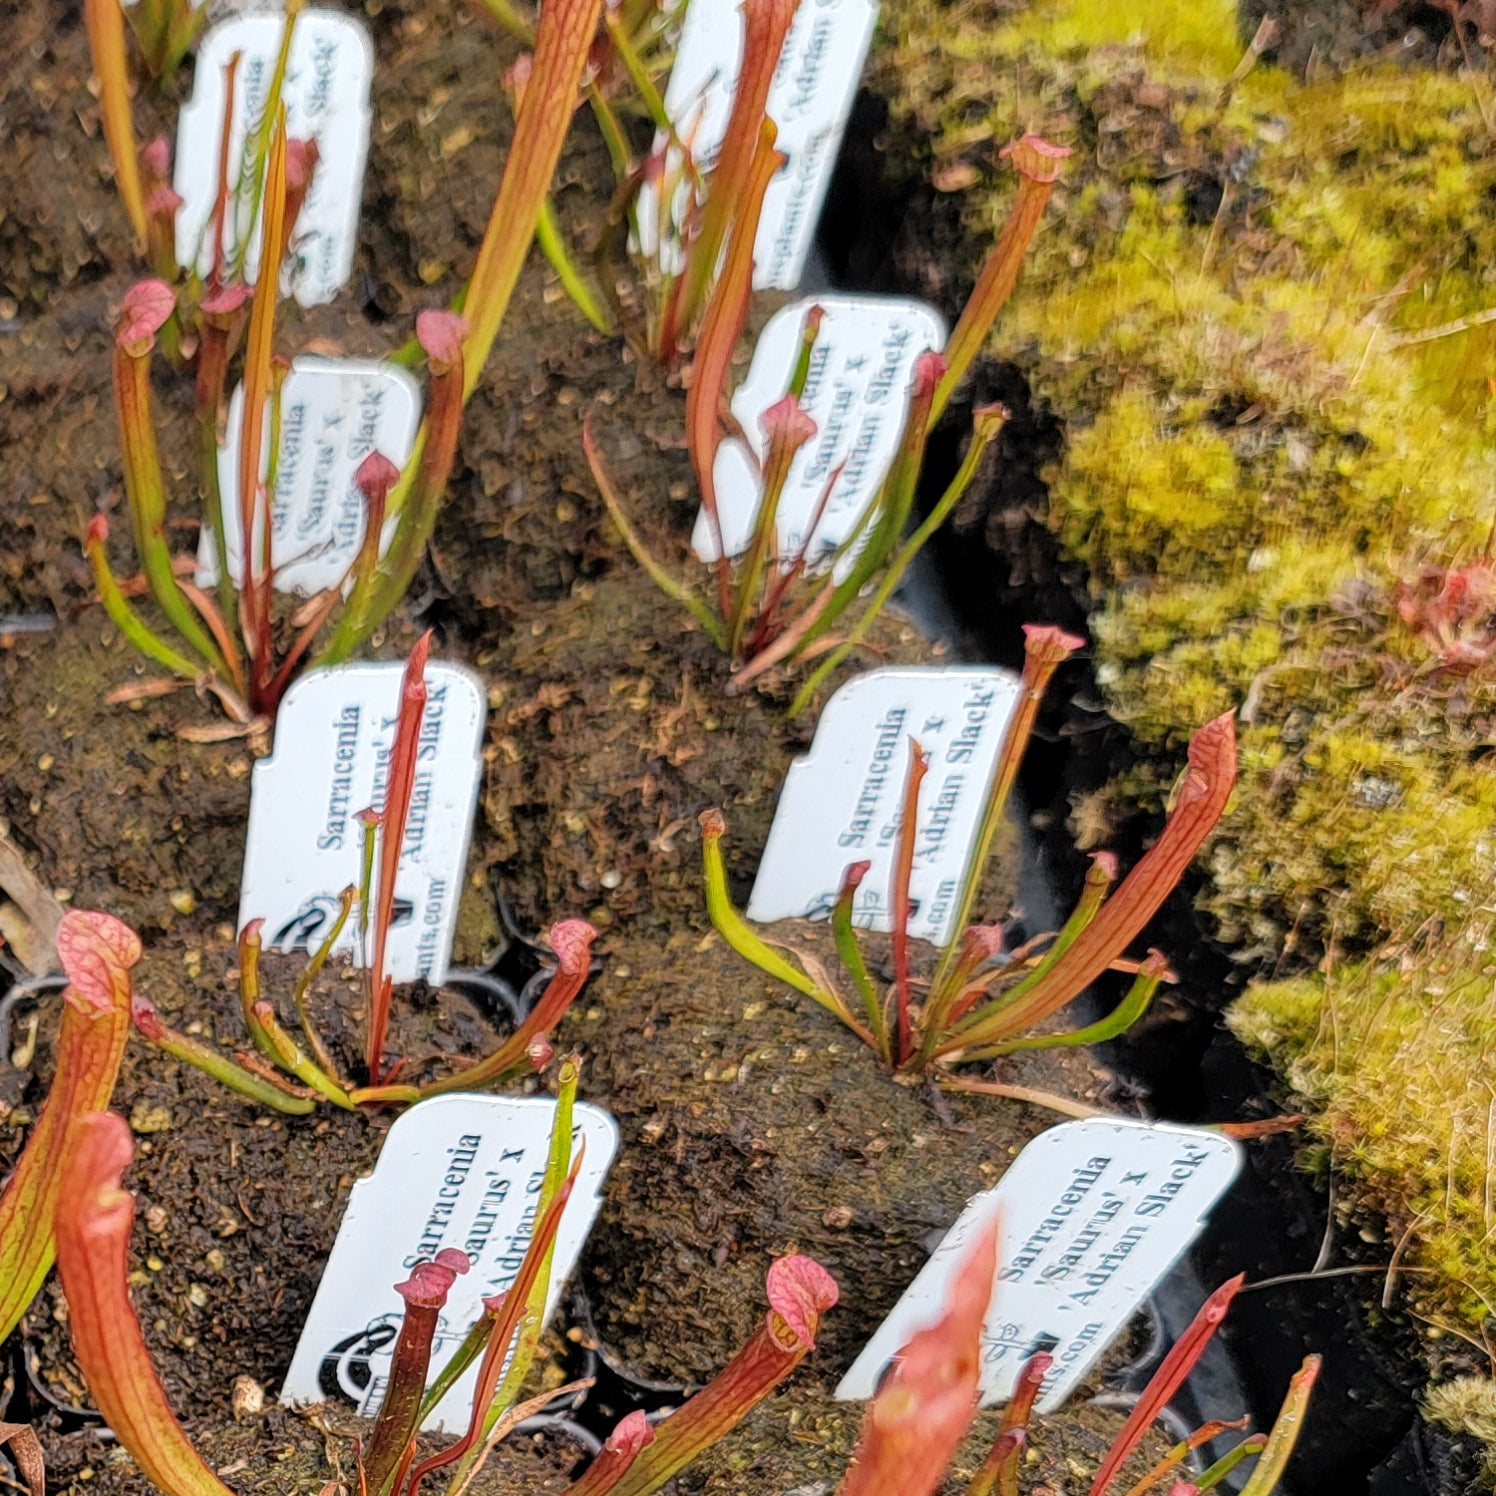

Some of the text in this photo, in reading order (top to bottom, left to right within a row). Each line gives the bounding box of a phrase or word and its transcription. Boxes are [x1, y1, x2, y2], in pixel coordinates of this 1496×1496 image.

[317, 705, 361, 851] Sarracenia
[837, 707, 907, 849] Sarracenia
[945, 682, 995, 764] Slack'
[402, 1132, 482, 1270] Sarracenia
[499, 1147, 526, 1164] x
[996, 1155, 1113, 1284] Sarracenia
[1034, 1168, 1148, 1286] 'Saurus' x
[1057, 1142, 1210, 1312] 'Adrian Slack'
